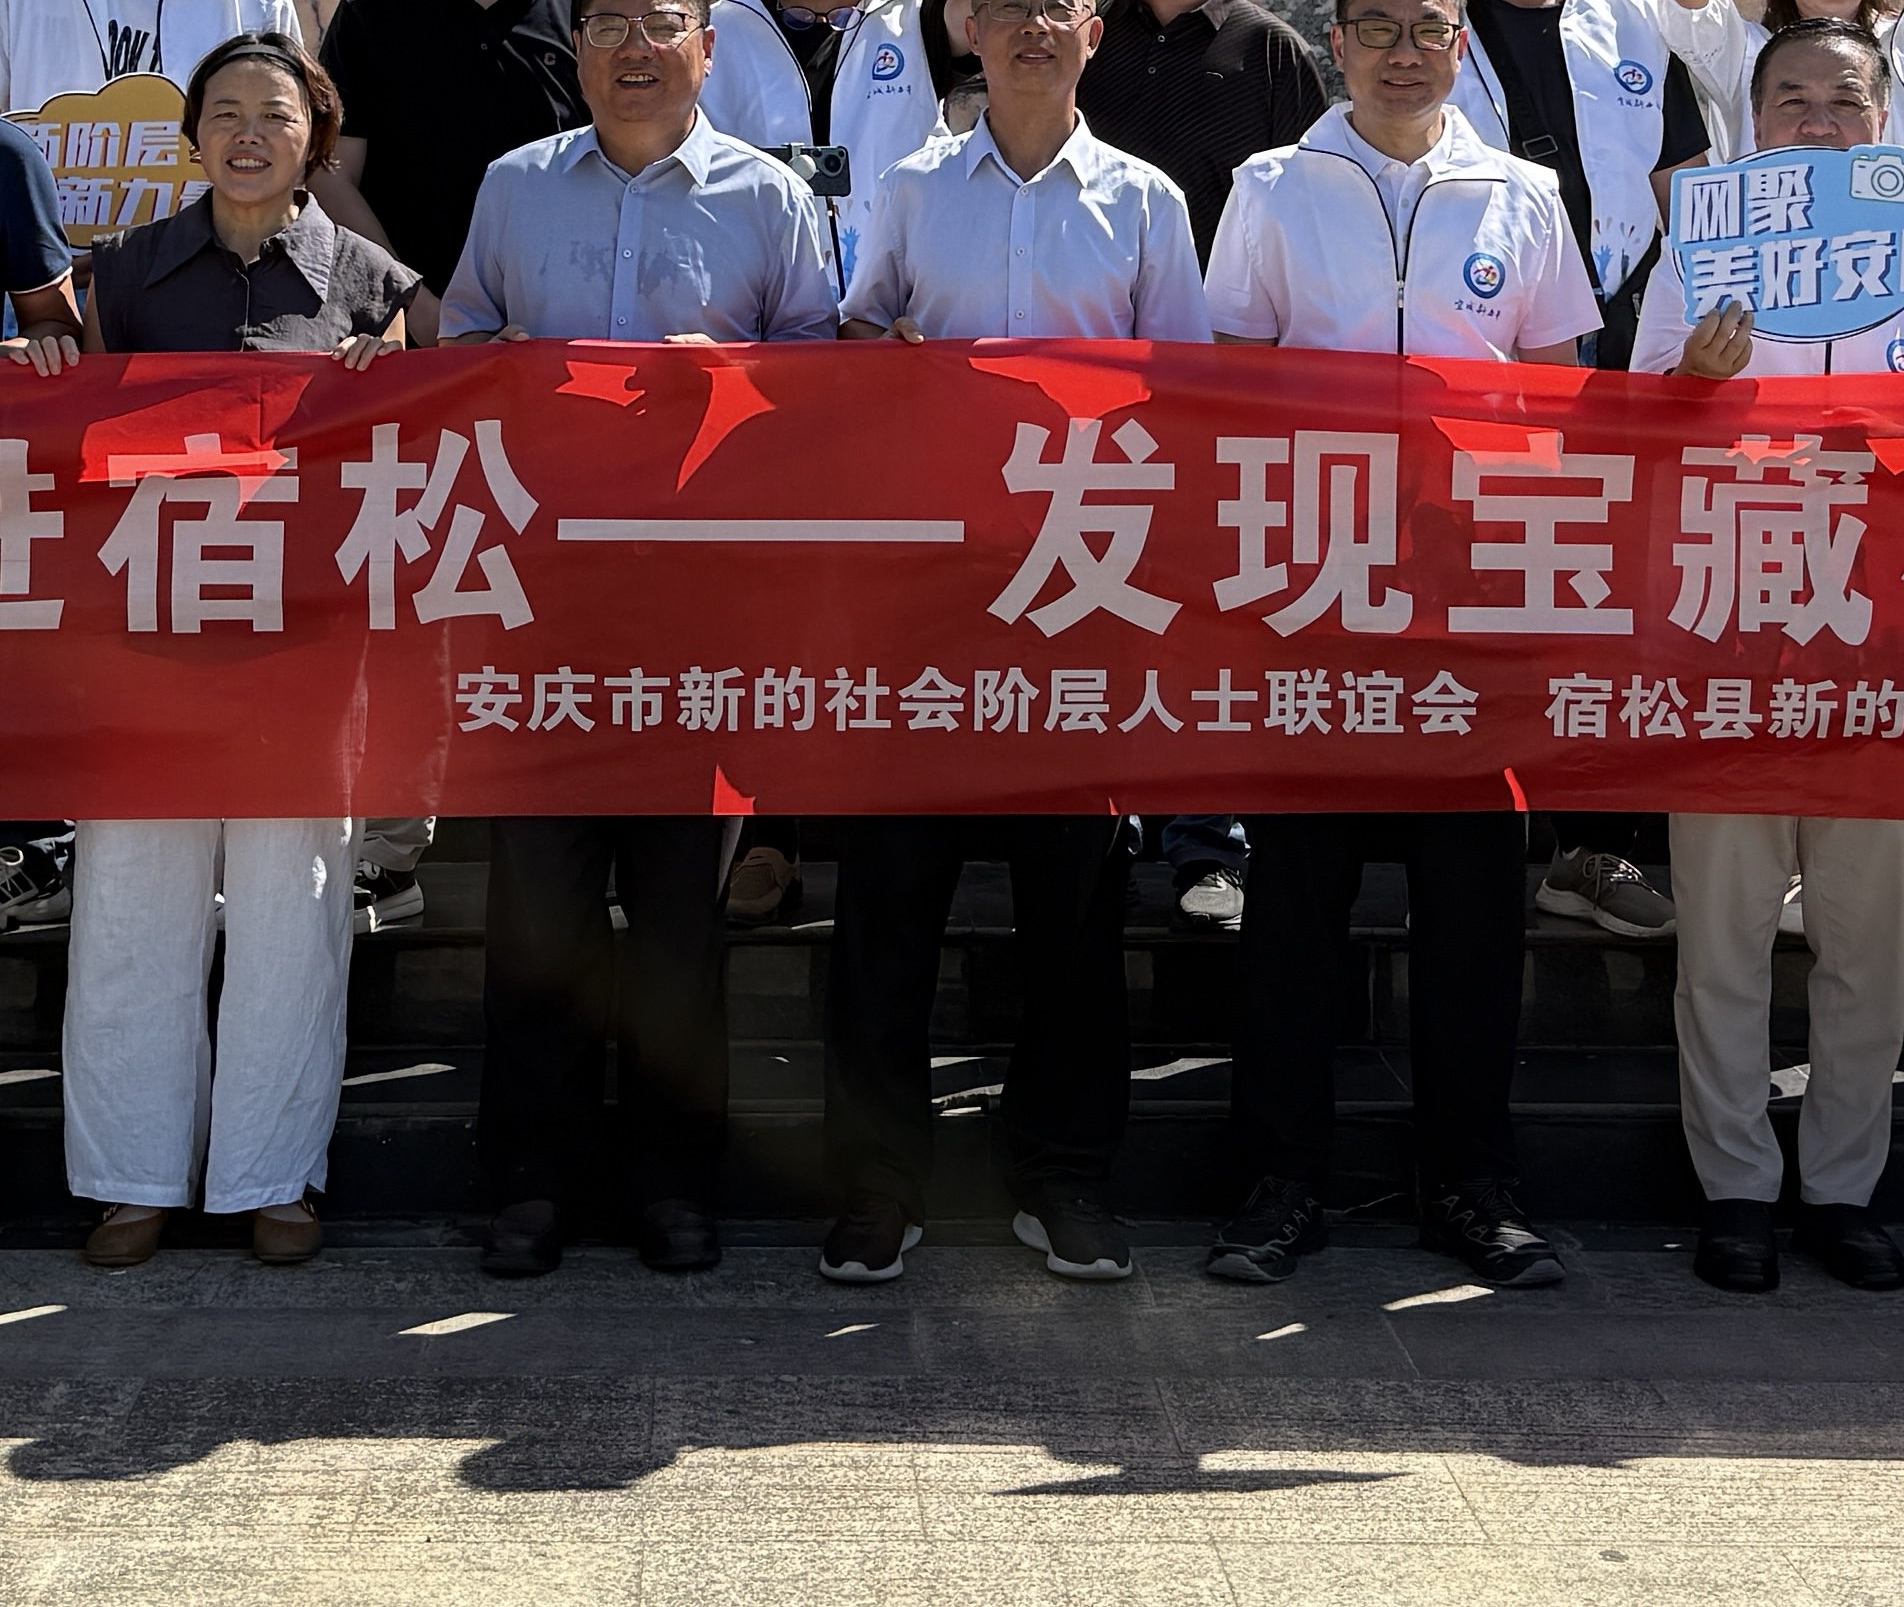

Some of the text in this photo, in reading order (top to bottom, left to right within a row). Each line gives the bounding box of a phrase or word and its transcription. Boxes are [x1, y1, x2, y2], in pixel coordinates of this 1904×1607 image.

[1679, 164, 1815, 243] 网聚
[455, 666, 1480, 736] 安庆市新的社会阶层人士联谊会
